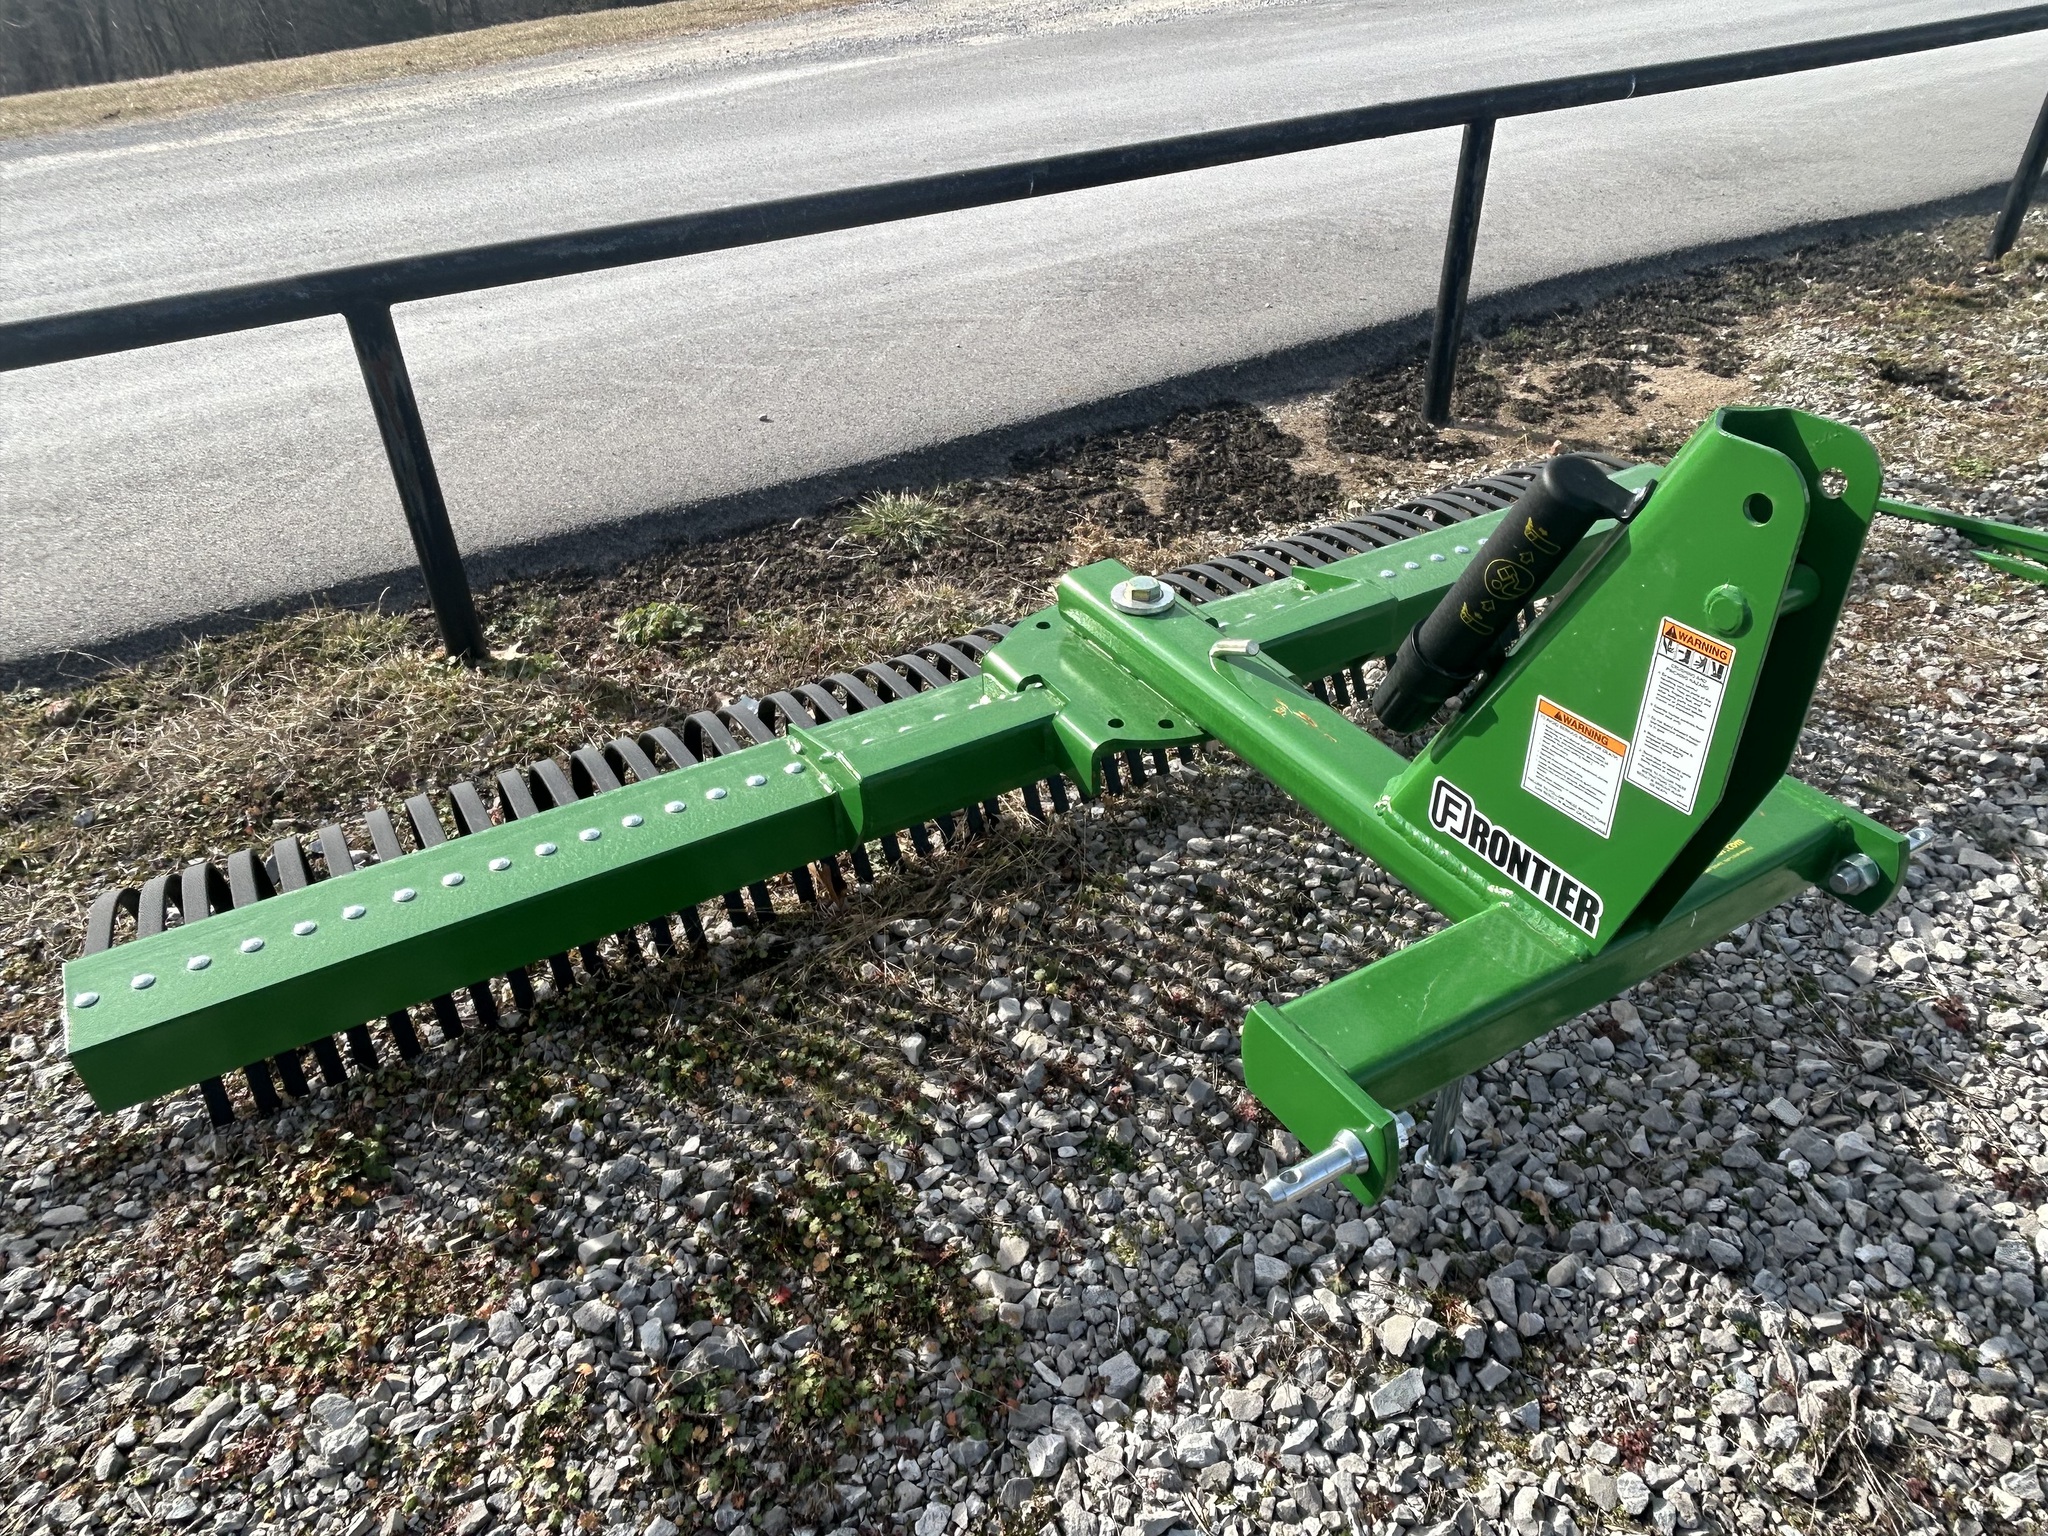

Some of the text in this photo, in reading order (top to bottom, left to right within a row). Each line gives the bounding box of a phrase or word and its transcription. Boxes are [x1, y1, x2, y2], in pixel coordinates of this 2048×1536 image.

[1678, 630, 1728, 660] WARNING
[1563, 714, 1609, 746] WARNING
[1432, 780, 1600, 934] FRONTIER
